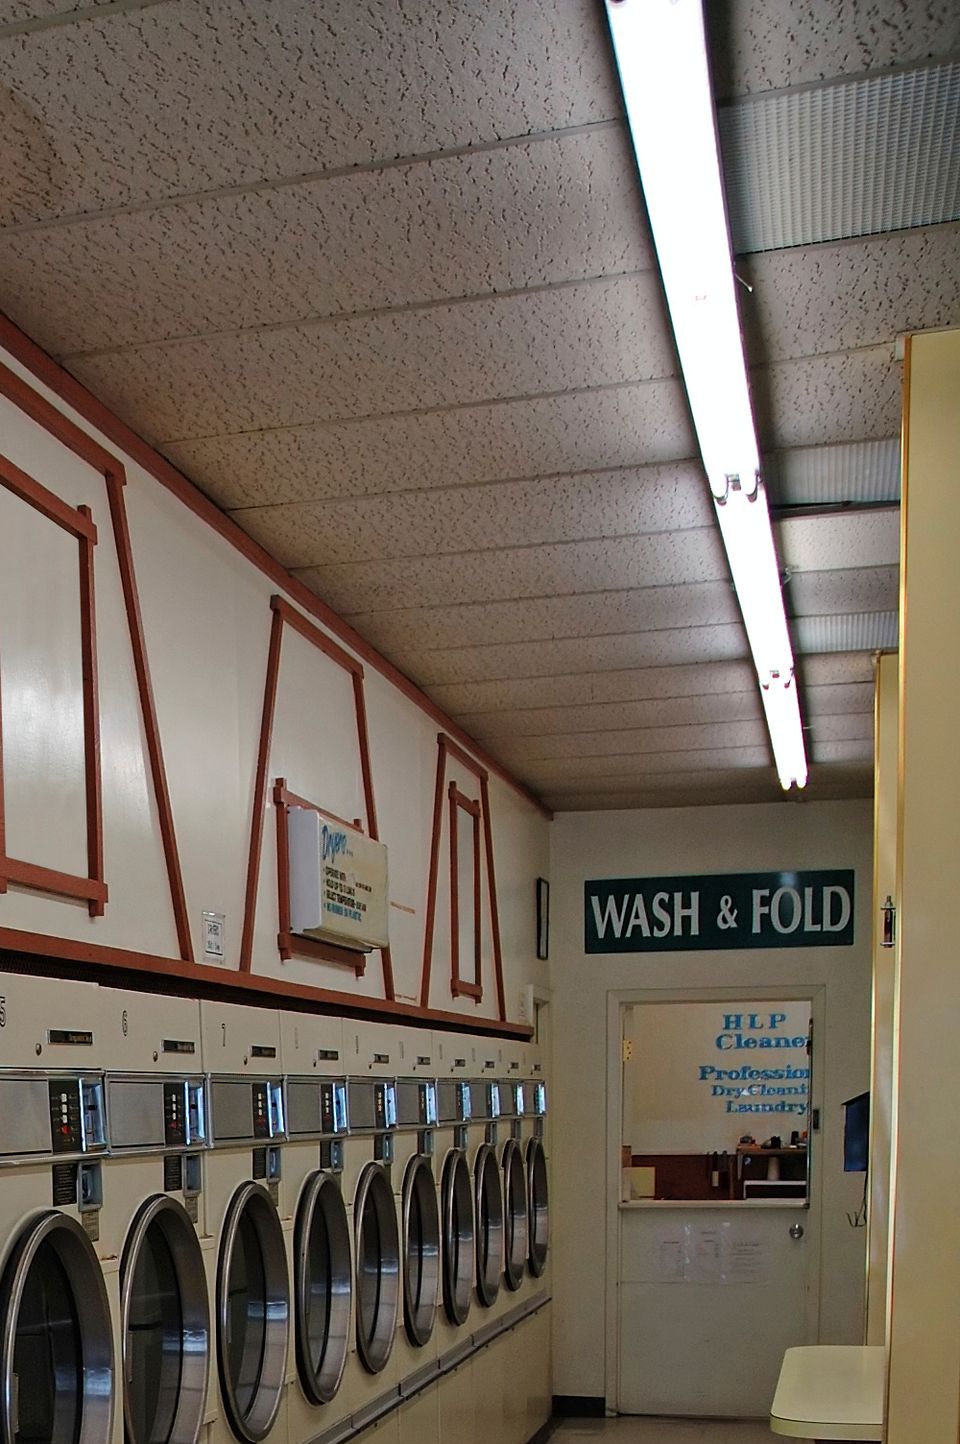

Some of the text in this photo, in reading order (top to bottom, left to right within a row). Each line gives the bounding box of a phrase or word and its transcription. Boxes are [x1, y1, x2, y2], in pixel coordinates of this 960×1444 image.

[590, 885, 852, 939] WASH & FOLD
[726, 1100, 807, 1115] Laundry
